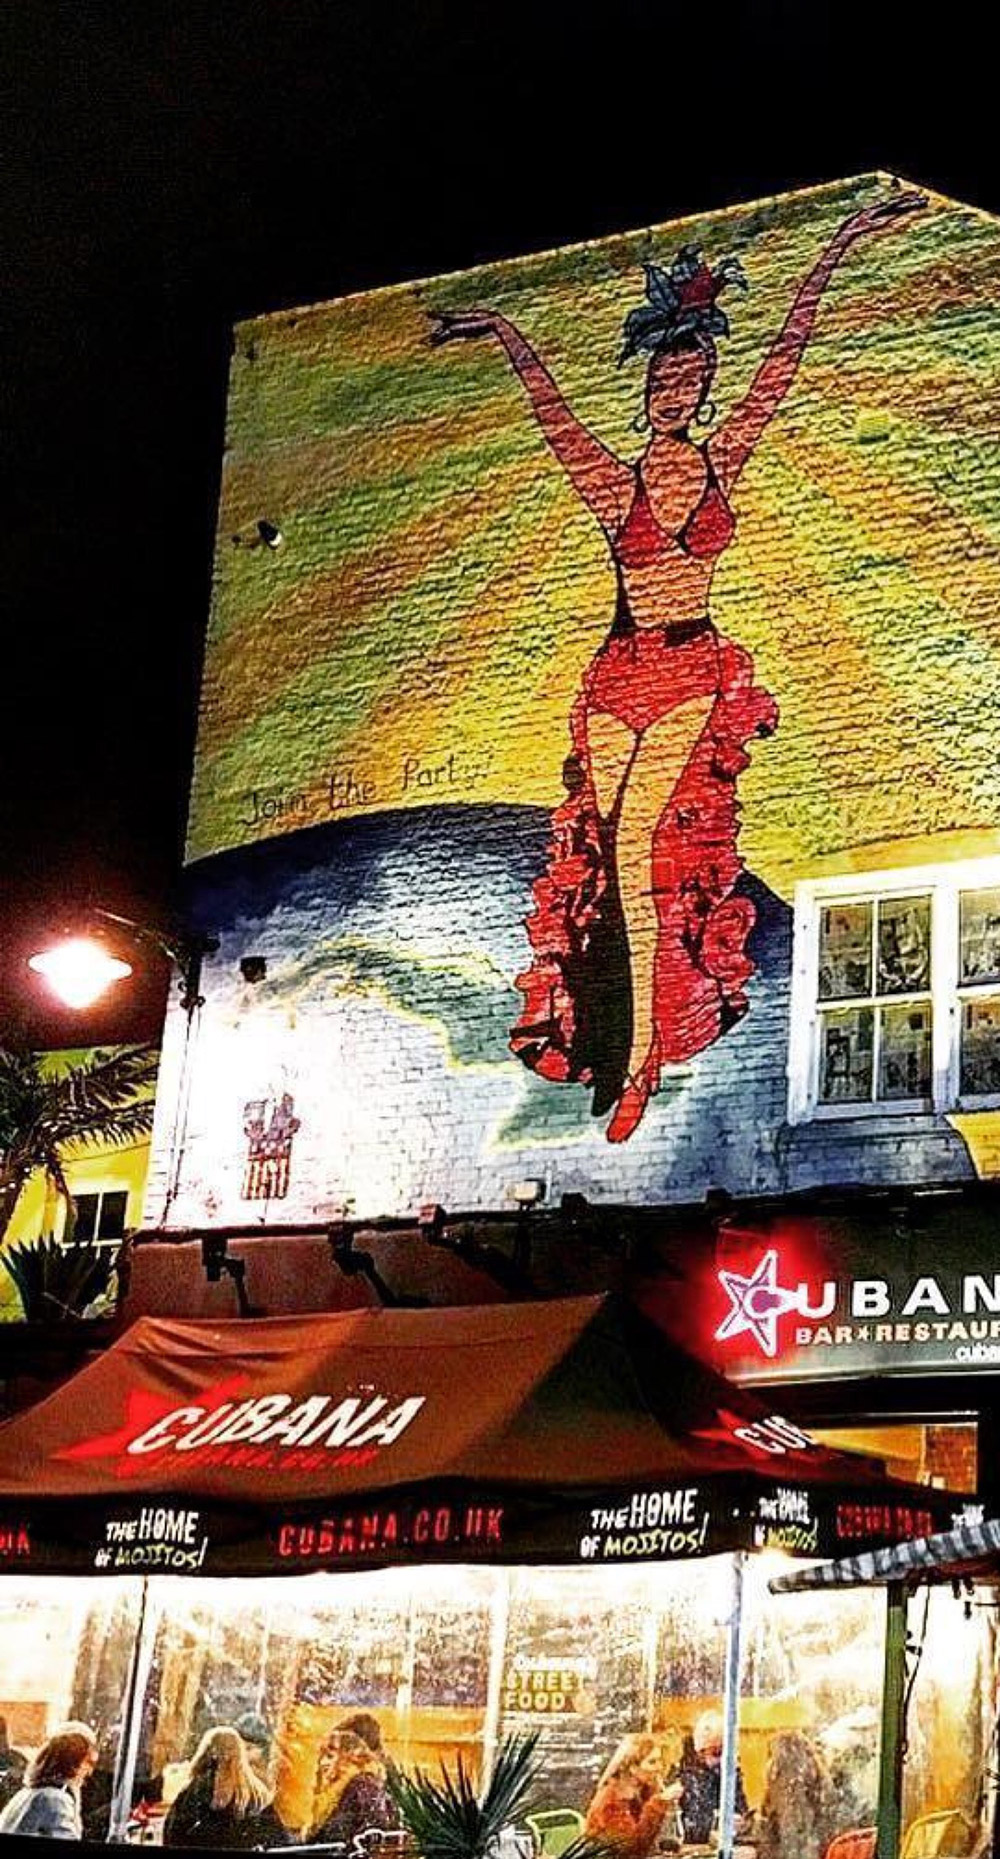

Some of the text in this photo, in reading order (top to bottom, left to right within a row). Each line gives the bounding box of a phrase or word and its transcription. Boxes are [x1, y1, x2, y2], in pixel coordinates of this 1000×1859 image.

[795, 1325, 852, 1346] BAR
[127, 1394, 426, 1454] CUBANA
[105, 1508, 199, 1543] THE HOME
[591, 1488, 699, 1531] THE HOME
[279, 1508, 504, 1556] CUBANA.CO.UK
[579, 1512, 710, 1559] OF MOJITOS!
[94, 1547, 112, 1568] OF
[506, 1671, 585, 1692] STREET
[504, 1693, 566, 1711] FOOD
